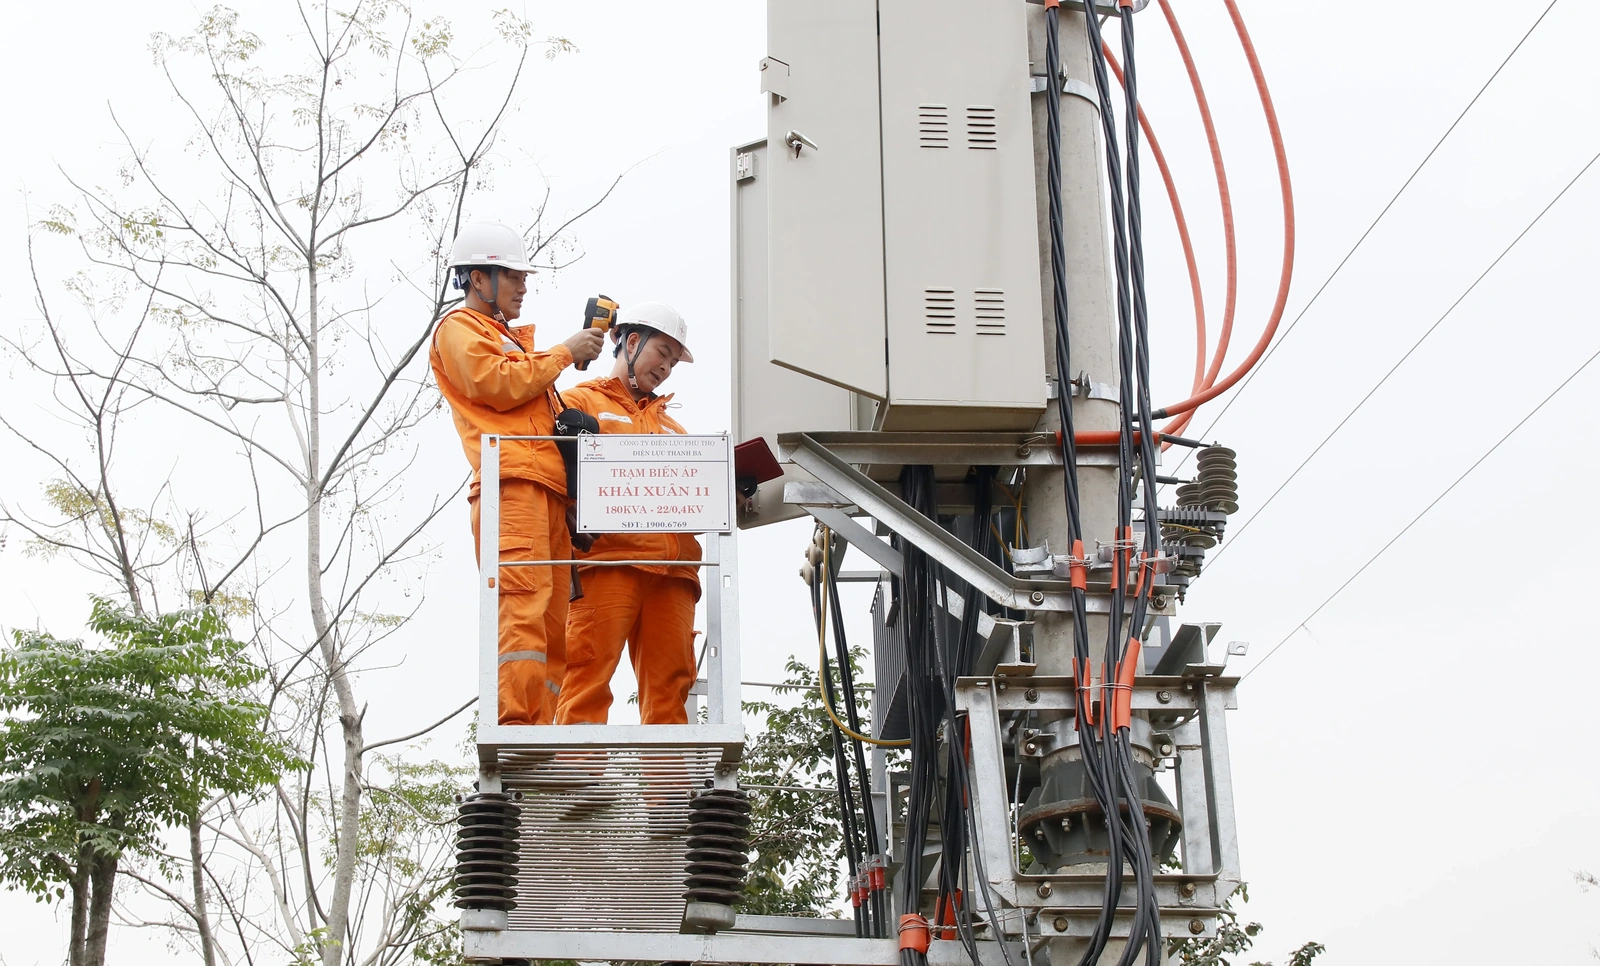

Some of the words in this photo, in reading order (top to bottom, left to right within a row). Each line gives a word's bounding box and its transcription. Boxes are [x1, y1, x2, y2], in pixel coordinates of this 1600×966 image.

[611, 468, 645, 479] TRẠM
[649, 465, 678, 477] BIẾN
[682, 466, 698, 477] ÁP
[598, 482, 639, 497] KHẢI
[644, 483, 689, 497] XUÂN
[695, 486, 710, 497] 11
[605, 505, 647, 514] 180KVA
[657, 505, 704, 515] 22/0,4KV
